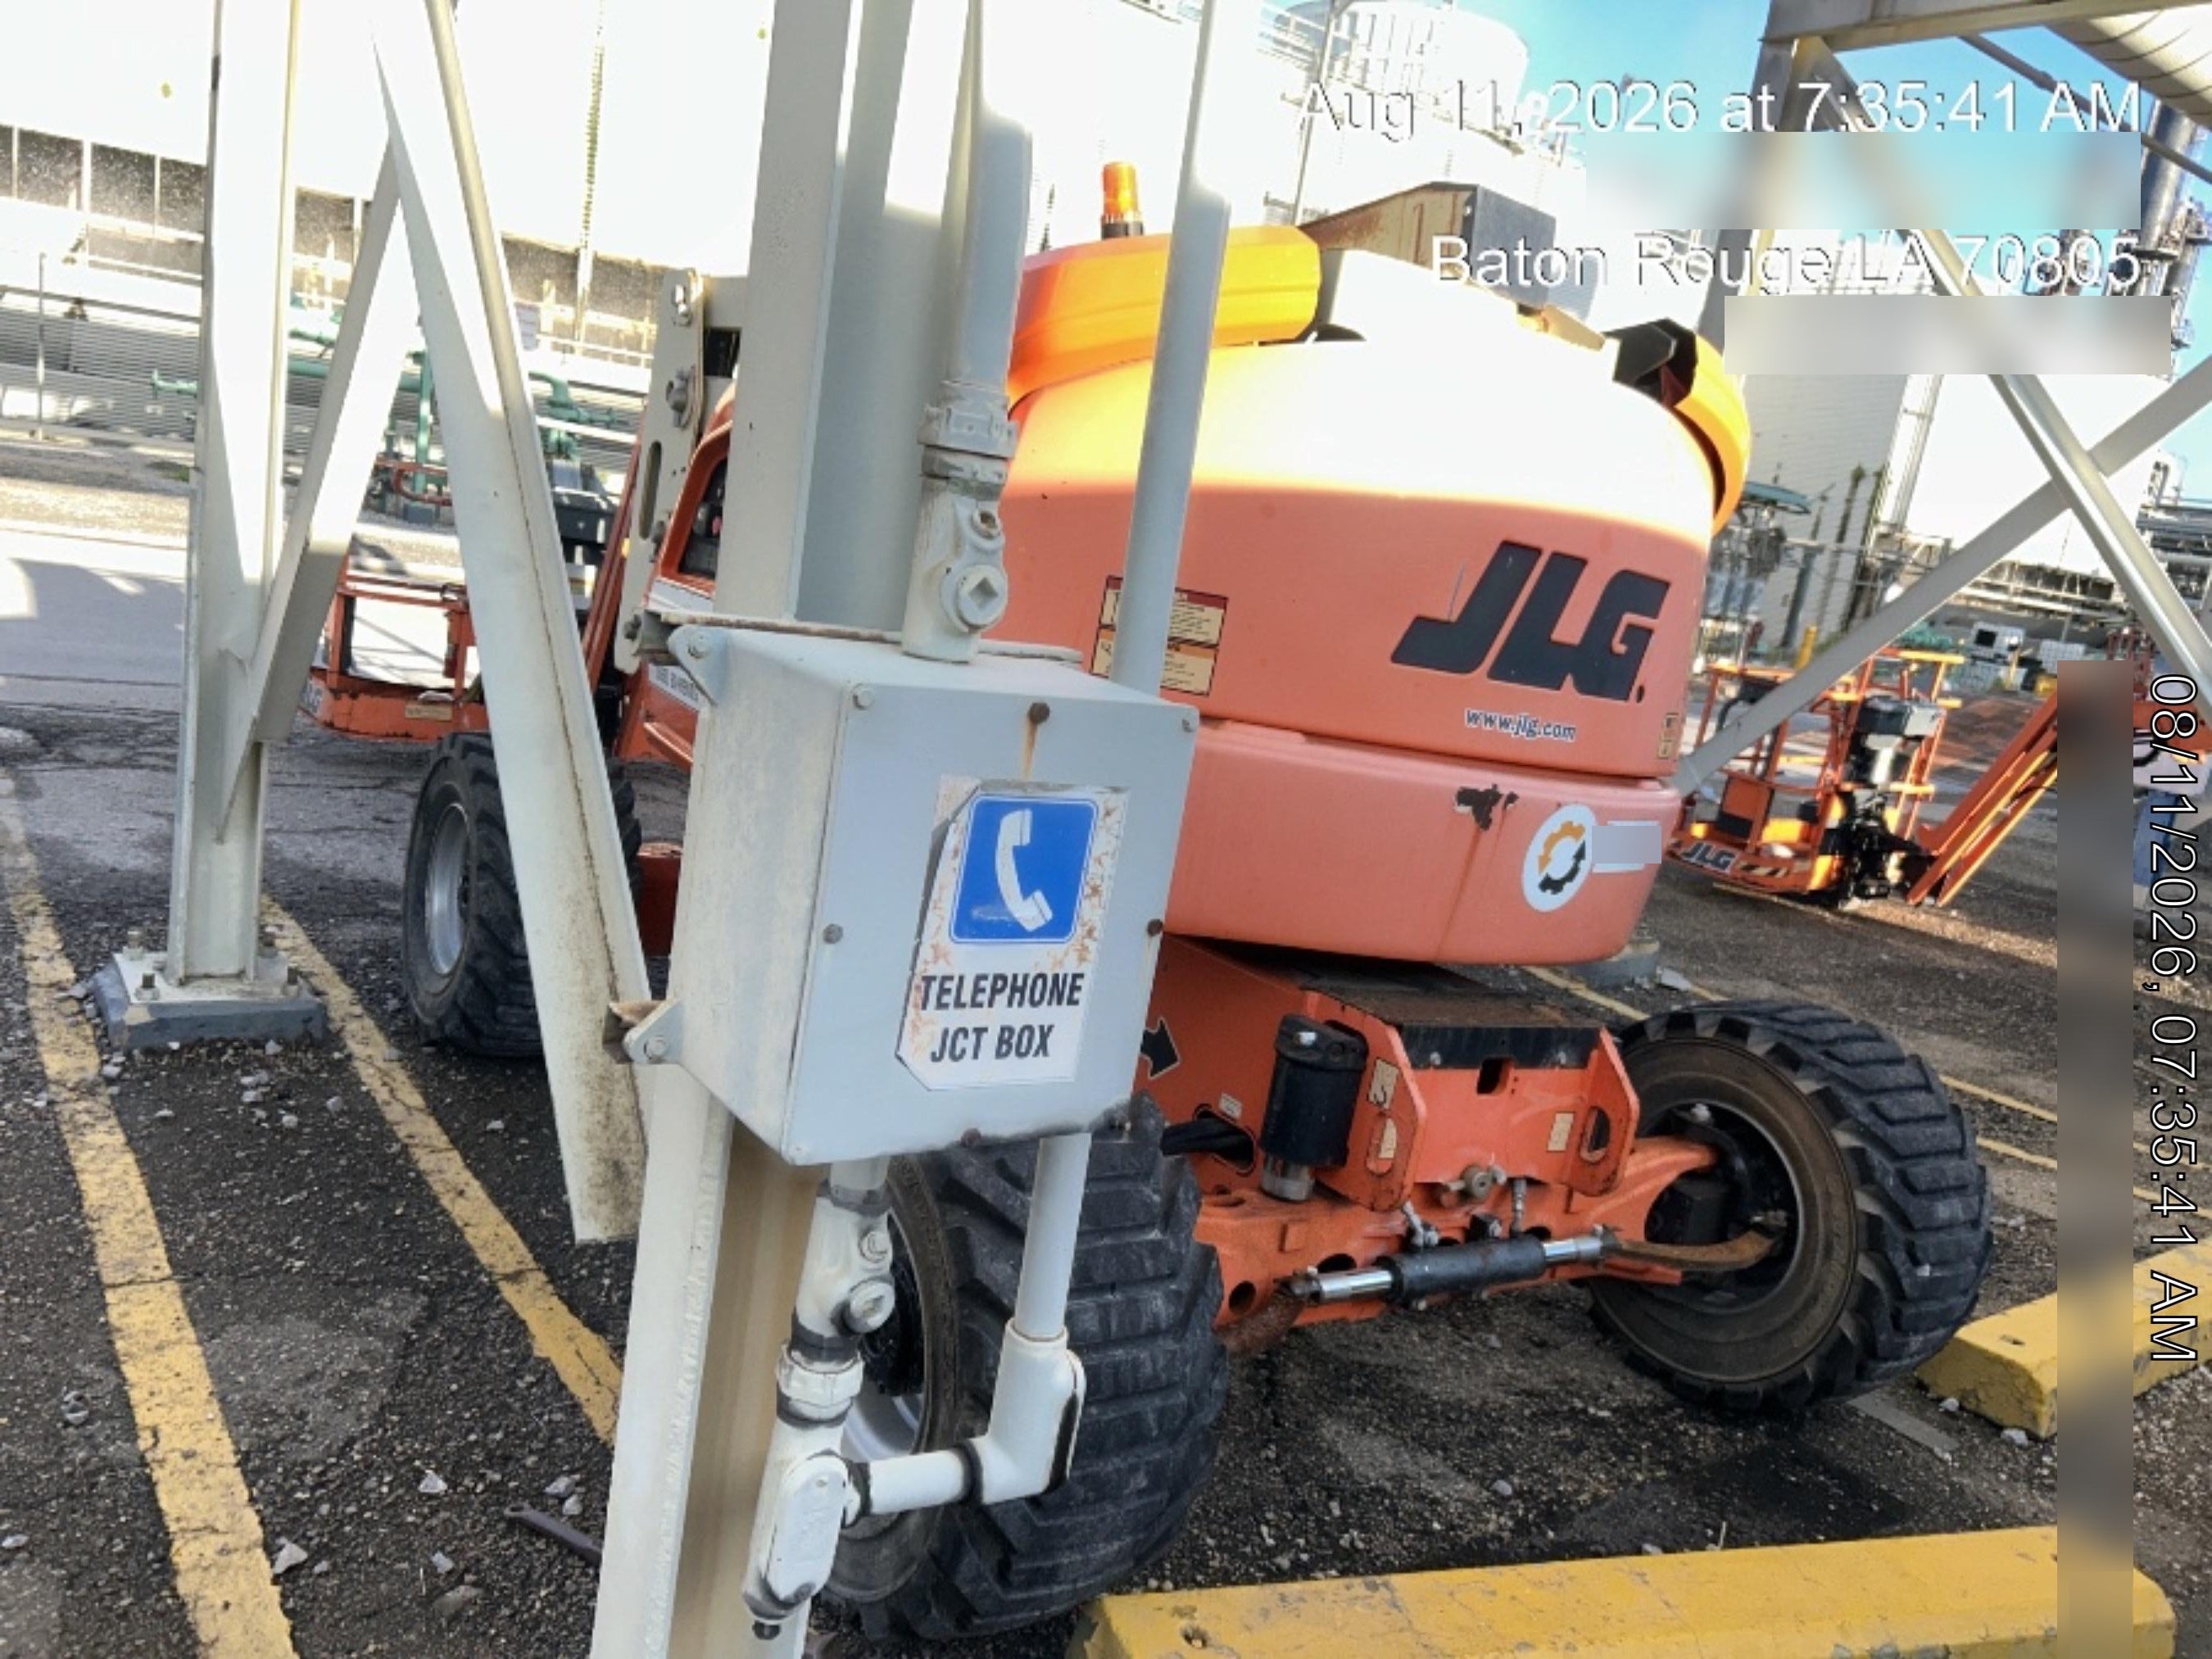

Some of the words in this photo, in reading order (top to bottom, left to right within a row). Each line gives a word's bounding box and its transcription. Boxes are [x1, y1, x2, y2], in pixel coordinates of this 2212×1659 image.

[1464, 708, 1577, 742] www.jlg.com
[1681, 841, 1737, 873] JLG
[919, 972, 1086, 1011] TELEPHONE
[931, 1026, 988, 1063] JCT
[995, 1024, 1055, 1060] BOX
